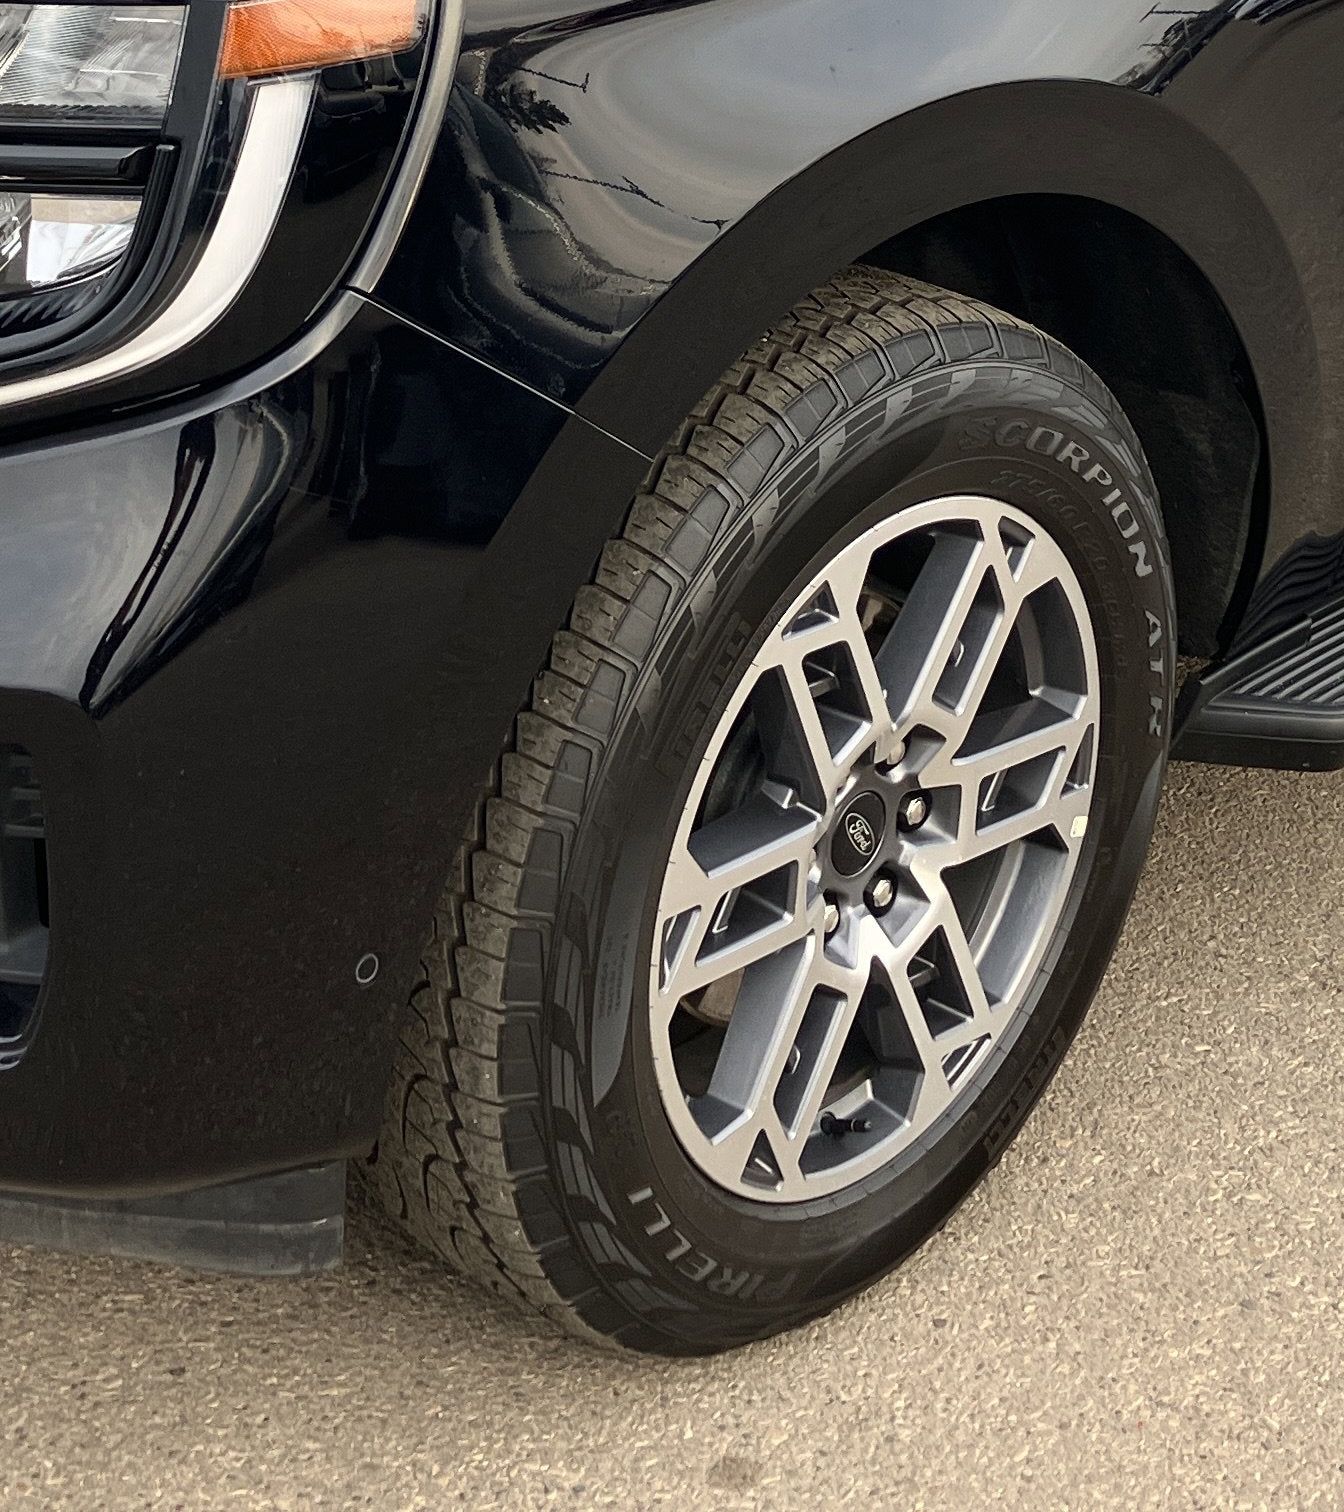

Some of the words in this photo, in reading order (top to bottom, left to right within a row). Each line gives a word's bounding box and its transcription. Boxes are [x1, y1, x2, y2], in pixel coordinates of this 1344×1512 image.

[958, 416, 1154, 578] SCORPION
[1143, 609, 1167, 738] ATR
[848, 819, 872, 851] Ford
[625, 1185, 799, 1304] PIRELLI
